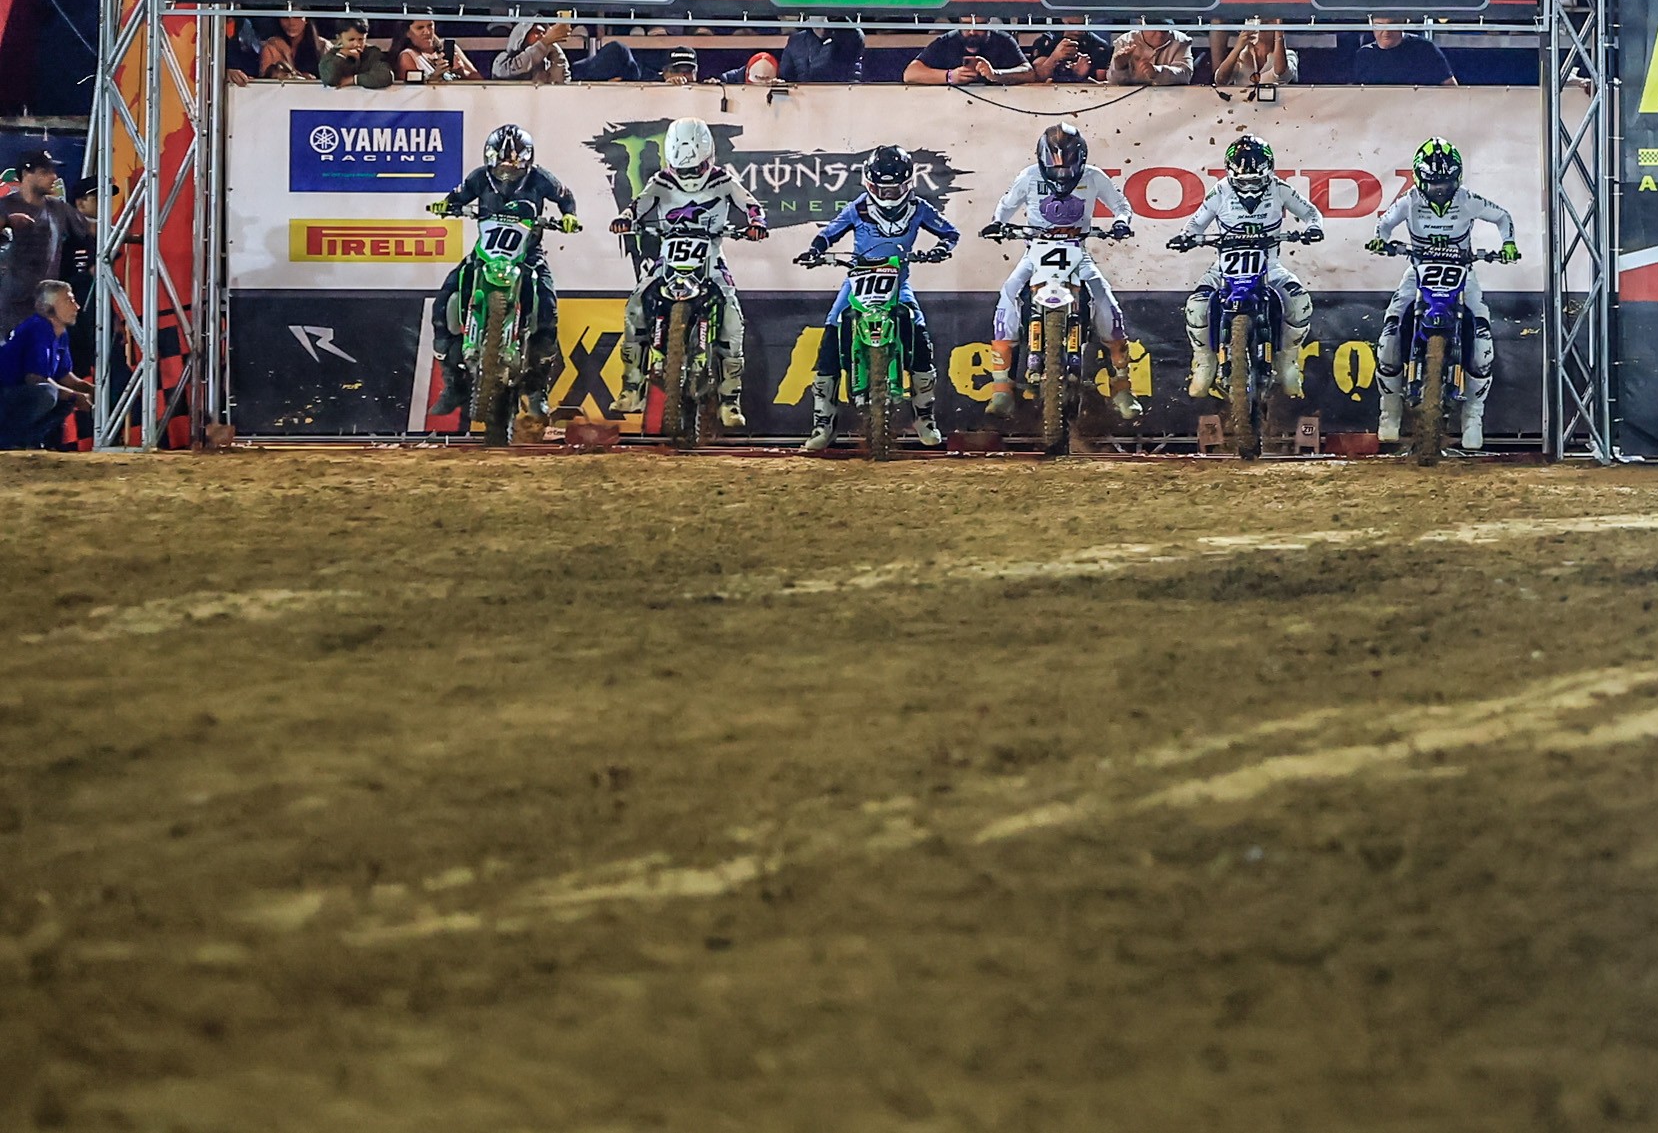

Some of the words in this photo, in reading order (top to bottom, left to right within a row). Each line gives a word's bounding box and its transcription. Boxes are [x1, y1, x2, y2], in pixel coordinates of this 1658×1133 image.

[340, 127, 443, 152] YAMAHA
[320, 154, 436, 162] RACING
[727, 156, 941, 194] MONSTR
[306, 226, 448, 256] PIRELLI
[485, 226, 523, 251] 10
[667, 241, 709, 263] 154
[1040, 247, 1071, 271] 4
[1224, 250, 1262, 275] 211
[854, 273, 894, 297] 110
[1422, 265, 1463, 286] 28
[699, 321, 708, 350] MOTUL
